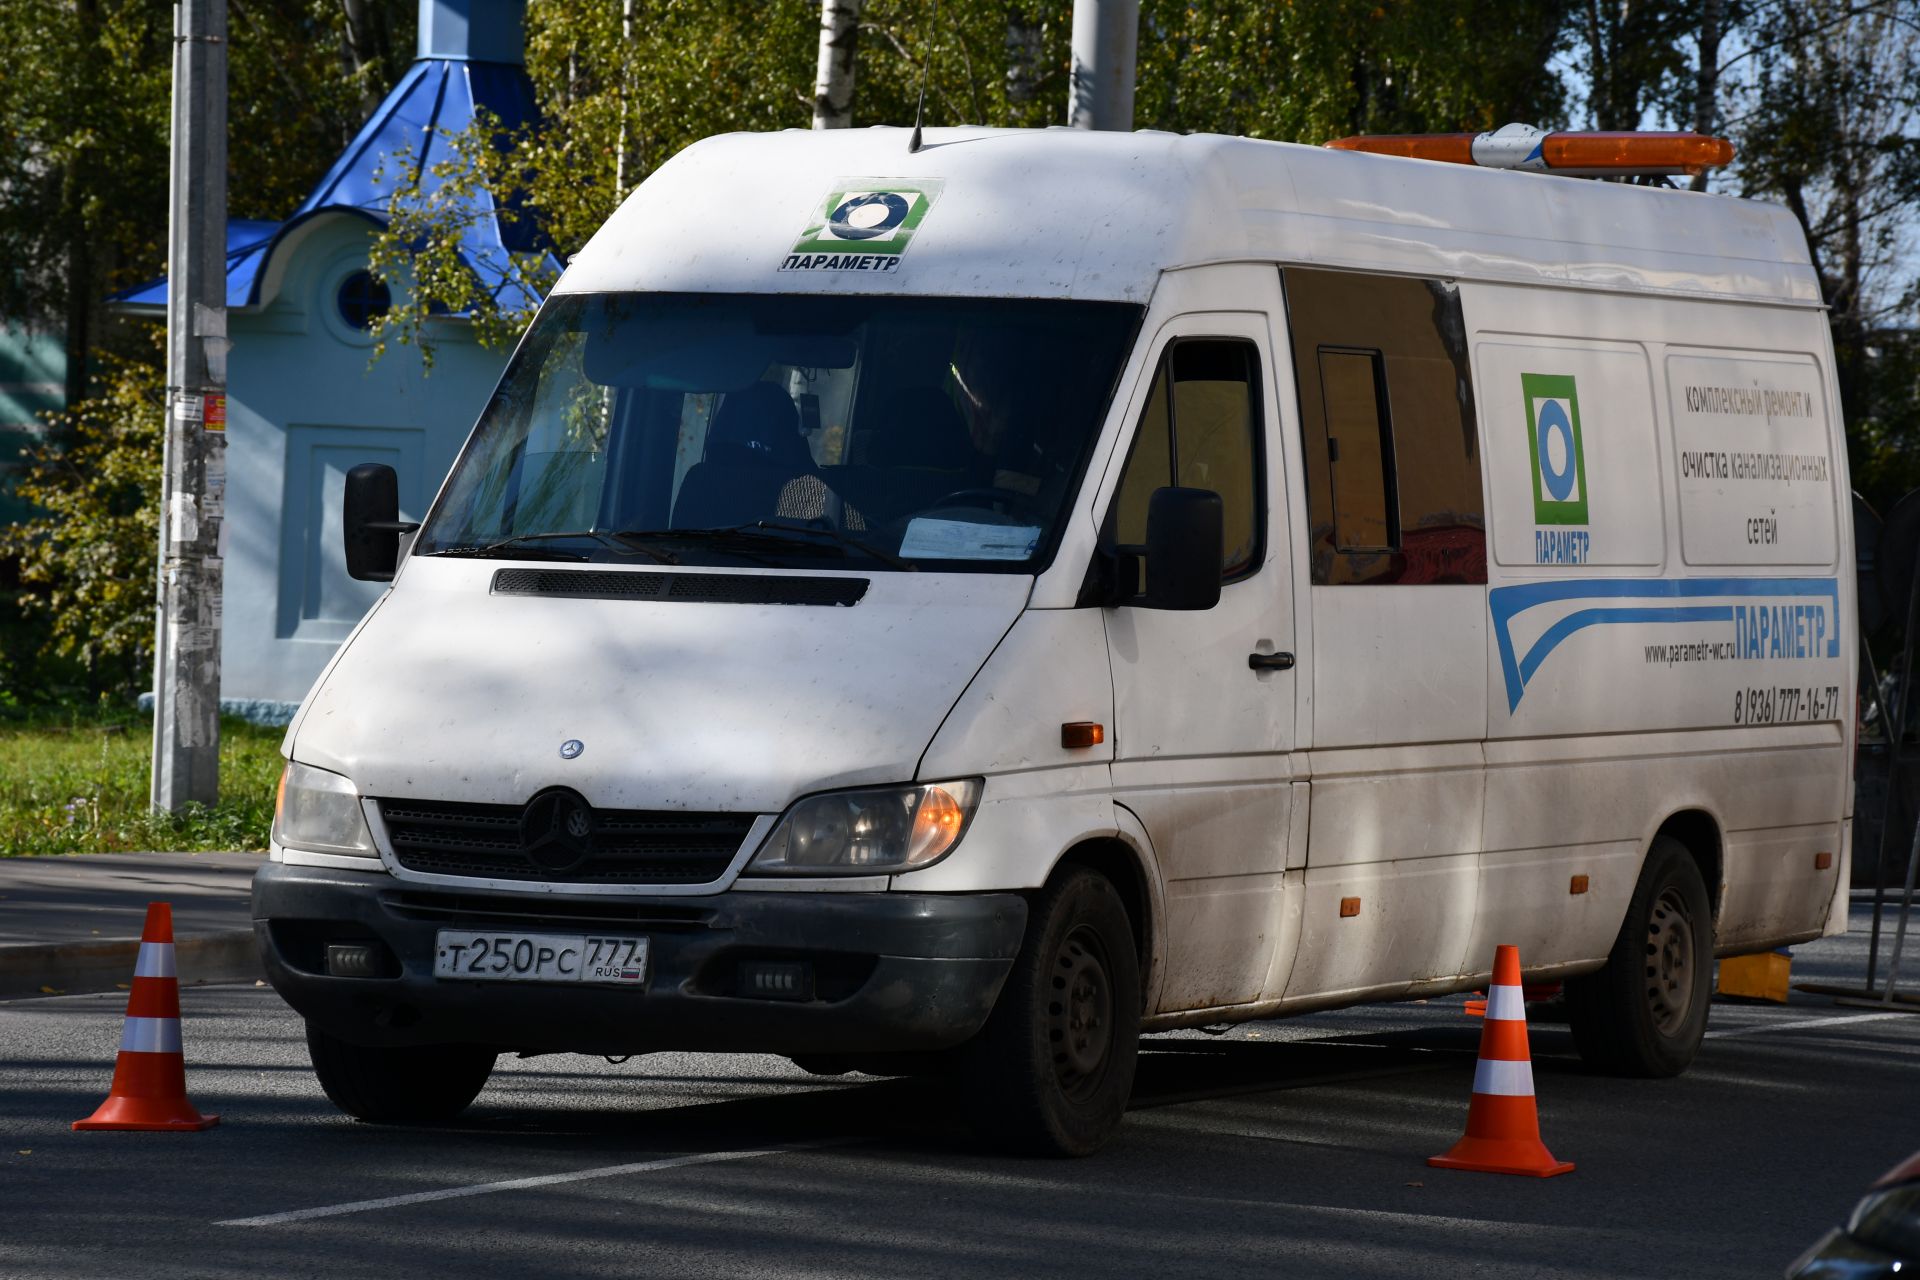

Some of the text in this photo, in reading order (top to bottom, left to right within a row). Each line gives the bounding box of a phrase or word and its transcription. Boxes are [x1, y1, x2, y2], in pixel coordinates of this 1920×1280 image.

[781, 255, 901, 271] ПАРАМЕТР
[1685, 377, 1763, 416] комплексный
[1764, 389, 1803, 426] ремонт
[1682, 451, 1829, 487] очистка канализационных
[1746, 508, 1779, 545] сетей
[1535, 530, 1590, 564] ПАРАМЕТР
[1735, 605, 1826, 660] ПАРАМЕТР
[1644, 640, 1736, 669] www.parametr-wc.ru
[1779, 686, 1840, 722] 777-16-77
[595, 967, 621, 978] RUS
